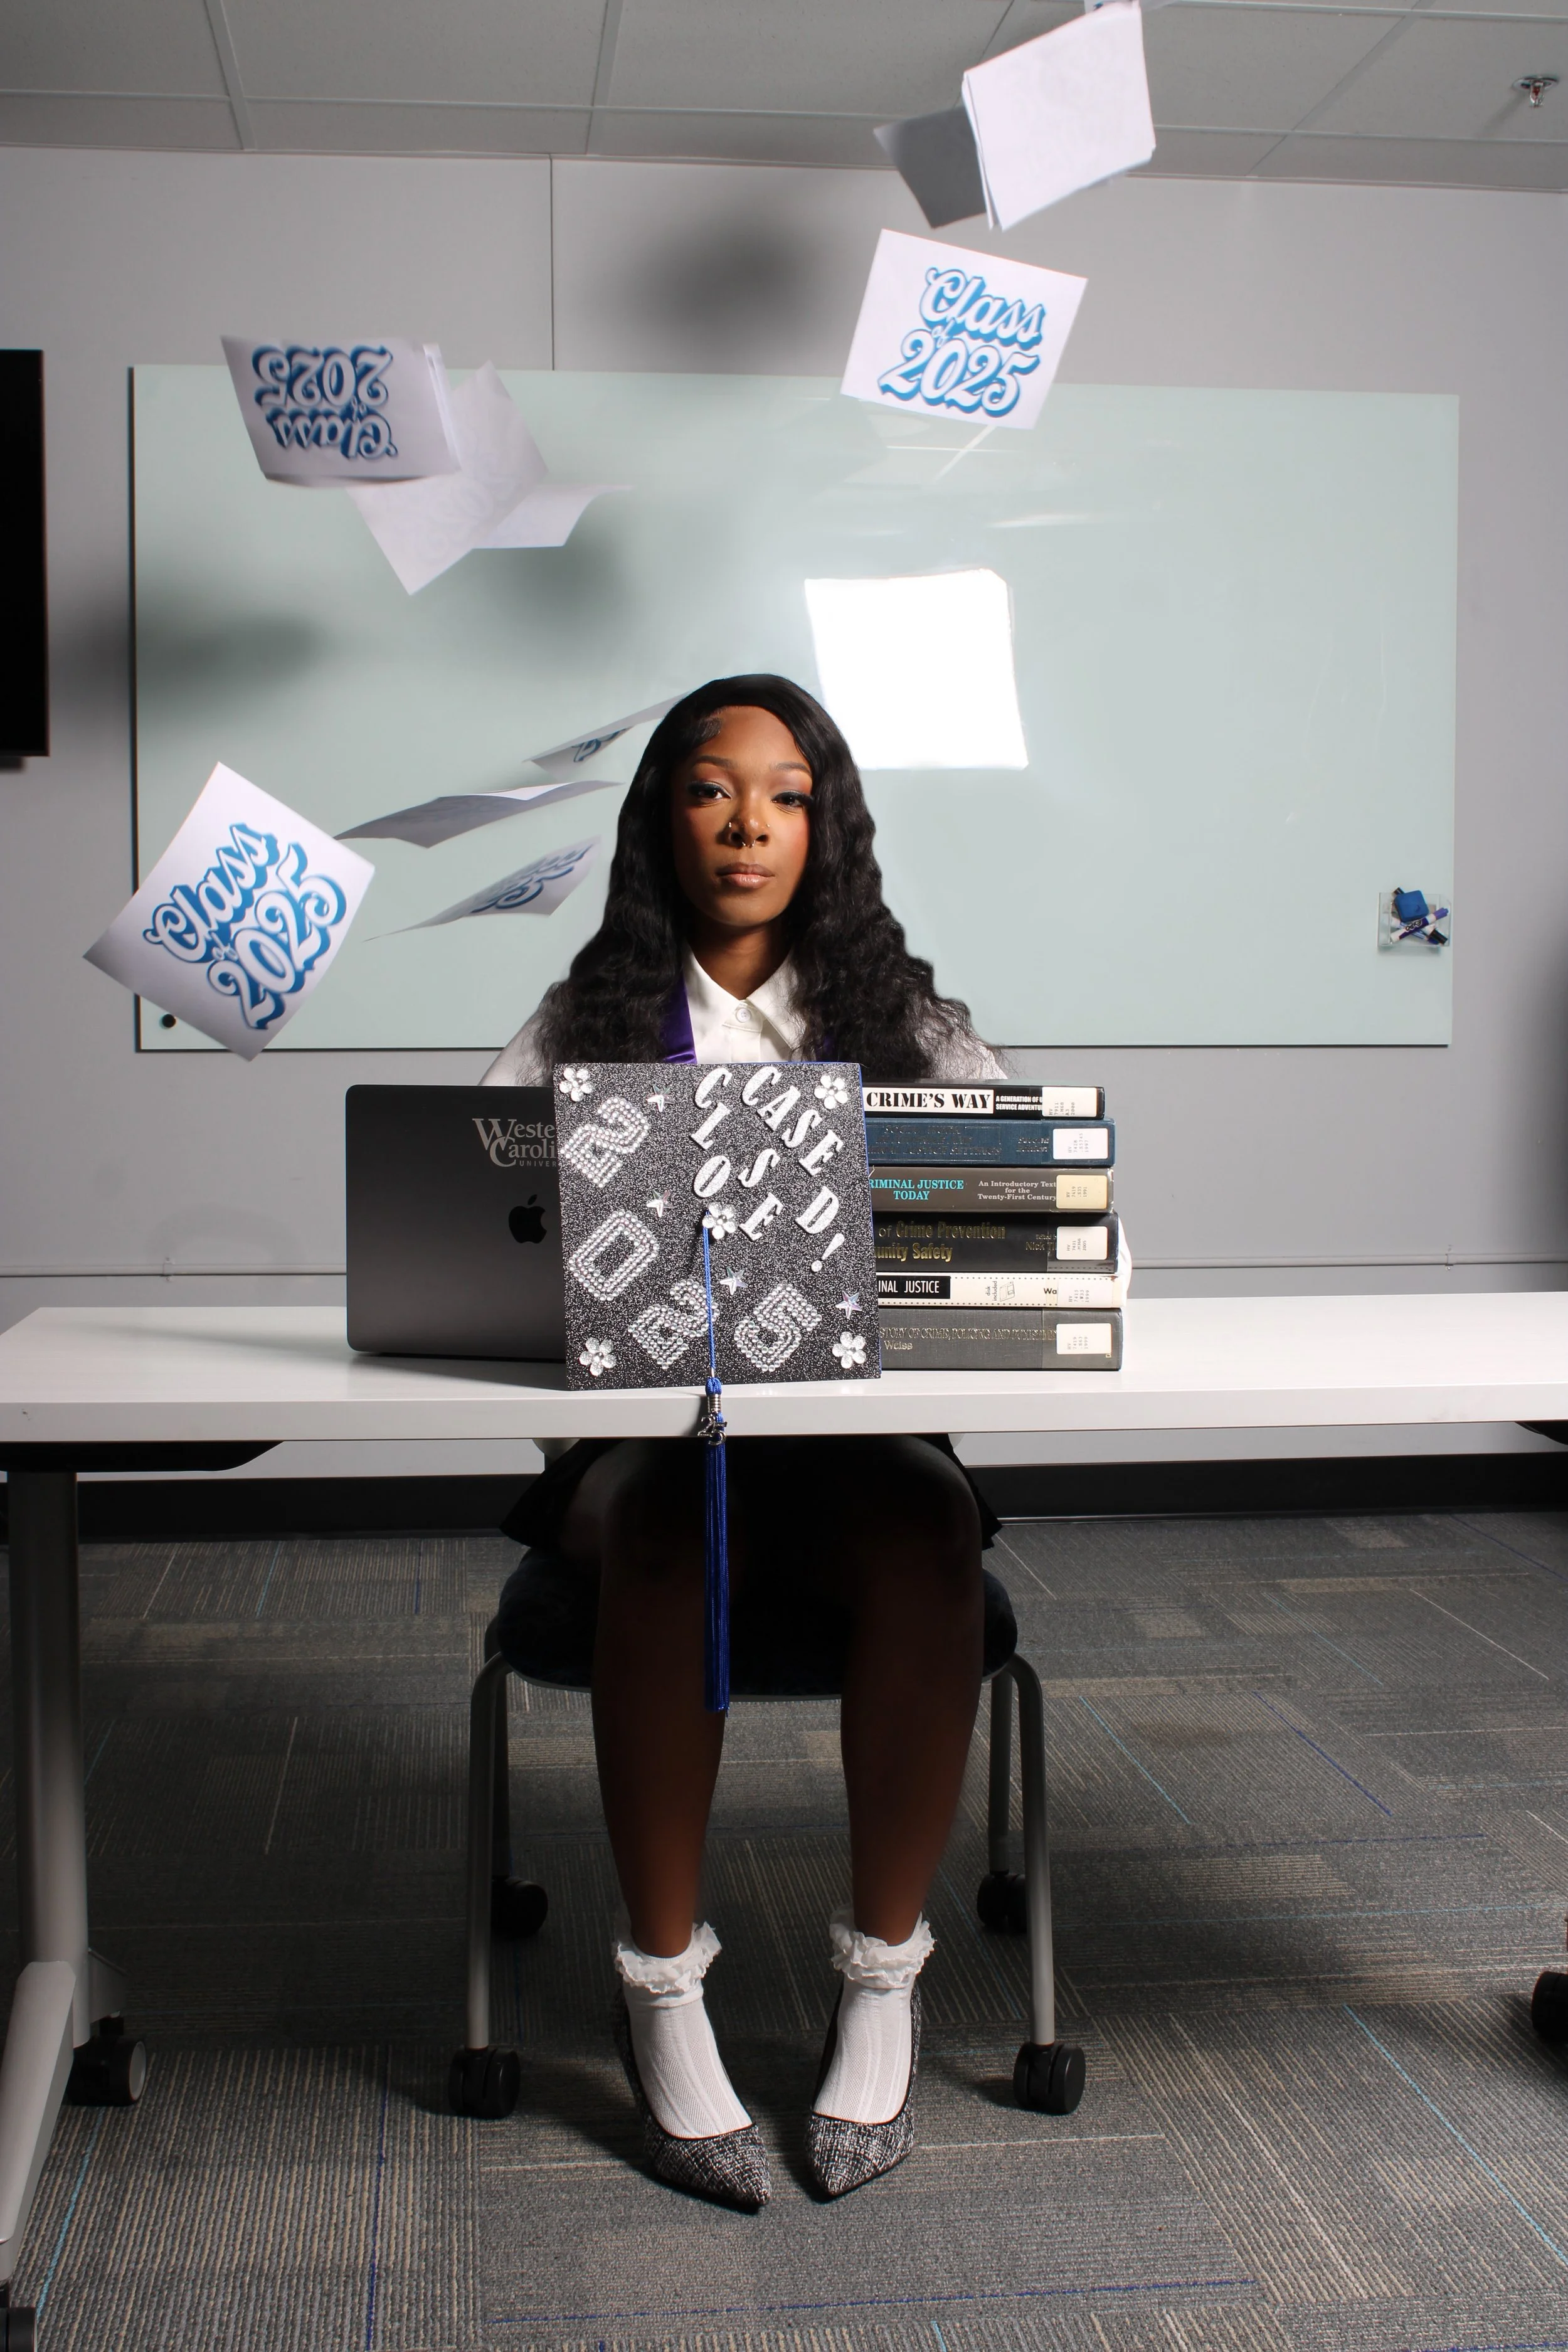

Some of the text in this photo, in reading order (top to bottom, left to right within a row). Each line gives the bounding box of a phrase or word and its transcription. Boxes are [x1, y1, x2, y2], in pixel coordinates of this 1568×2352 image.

[919, 267, 1046, 351] Class
[931, 317, 957, 347] of
[252, 345, 393, 408] 2025
[877, 329, 1040, 418] 2025
[266, 408, 399, 460] Class
[142, 822, 280, 963] Class
[207, 842, 347, 1030] 2025
[211, 930, 239, 960] of
[866, 1092, 991, 1109] CRIME'S WAY
[472, 1118, 555, 1151] Weste
[742, 1066, 844, 1176] CASE
[490, 1136, 556, 1167] Caroli
[869, 1179, 964, 1189] RIMINAL JUSTICE
[893, 1190, 930, 1200] TODAY
[879, 1221, 1006, 1239] of Crime Prevention
[913, 1242, 953, 1262] Safety
[1025, 1241, 1045, 1251] Nick
[878, 1280, 940, 1293] INAL JUSTICE
[879, 1327, 907, 1338] STORY
[909, 1328, 920, 1338] OF
[952, 1328, 990, 1339] POLICING
[993, 1328, 1010, 1339] AND
[884, 1340, 913, 1350] Weiss
[697, 1415, 728, 1446] 25
